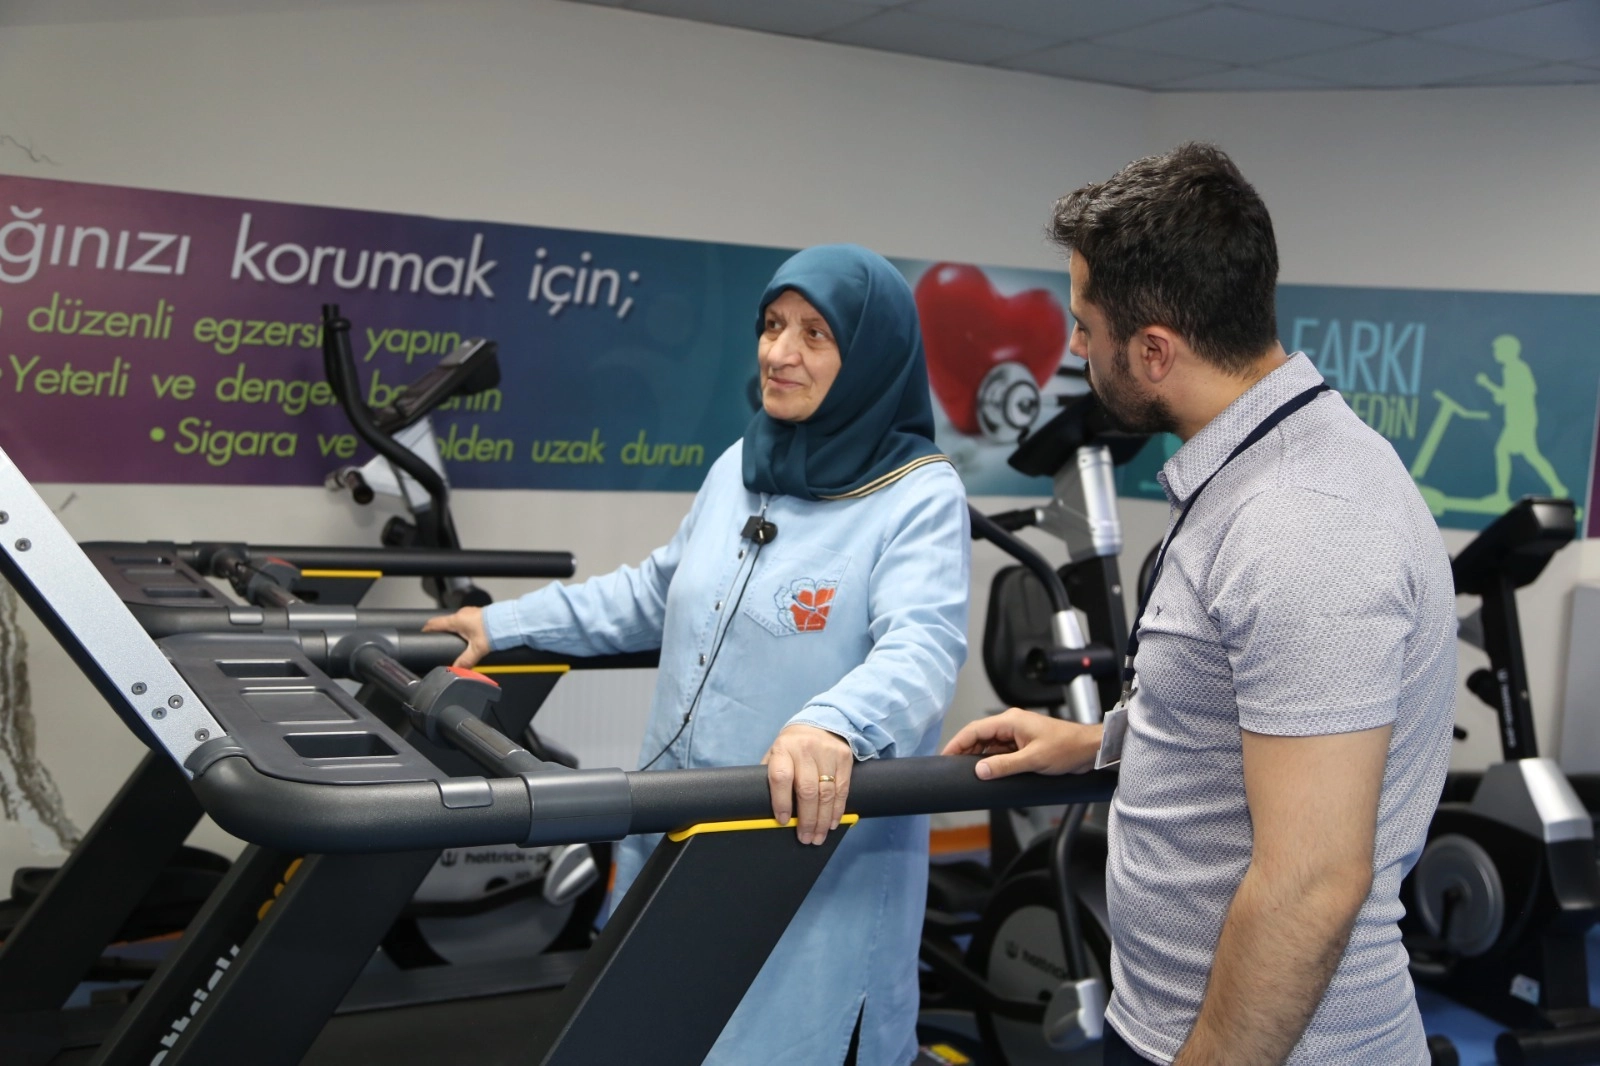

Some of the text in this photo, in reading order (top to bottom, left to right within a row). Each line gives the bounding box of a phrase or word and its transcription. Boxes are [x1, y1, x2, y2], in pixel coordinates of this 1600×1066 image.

[231, 212, 498, 298] korumak
[528, 248, 641, 318] için;
[27, 292, 174, 339] düzenli
[193, 315, 325, 355] egzersi
[9, 354, 131, 397] Yeterli
[151, 375, 196, 400] ve
[215, 363, 338, 416] denge
[1291, 317, 1426, 396] FARKI
[174, 416, 298, 466] Sigara
[317, 434, 357, 458] ve
[531, 429, 606, 464] uzak
[620, 432, 704, 466] durun
